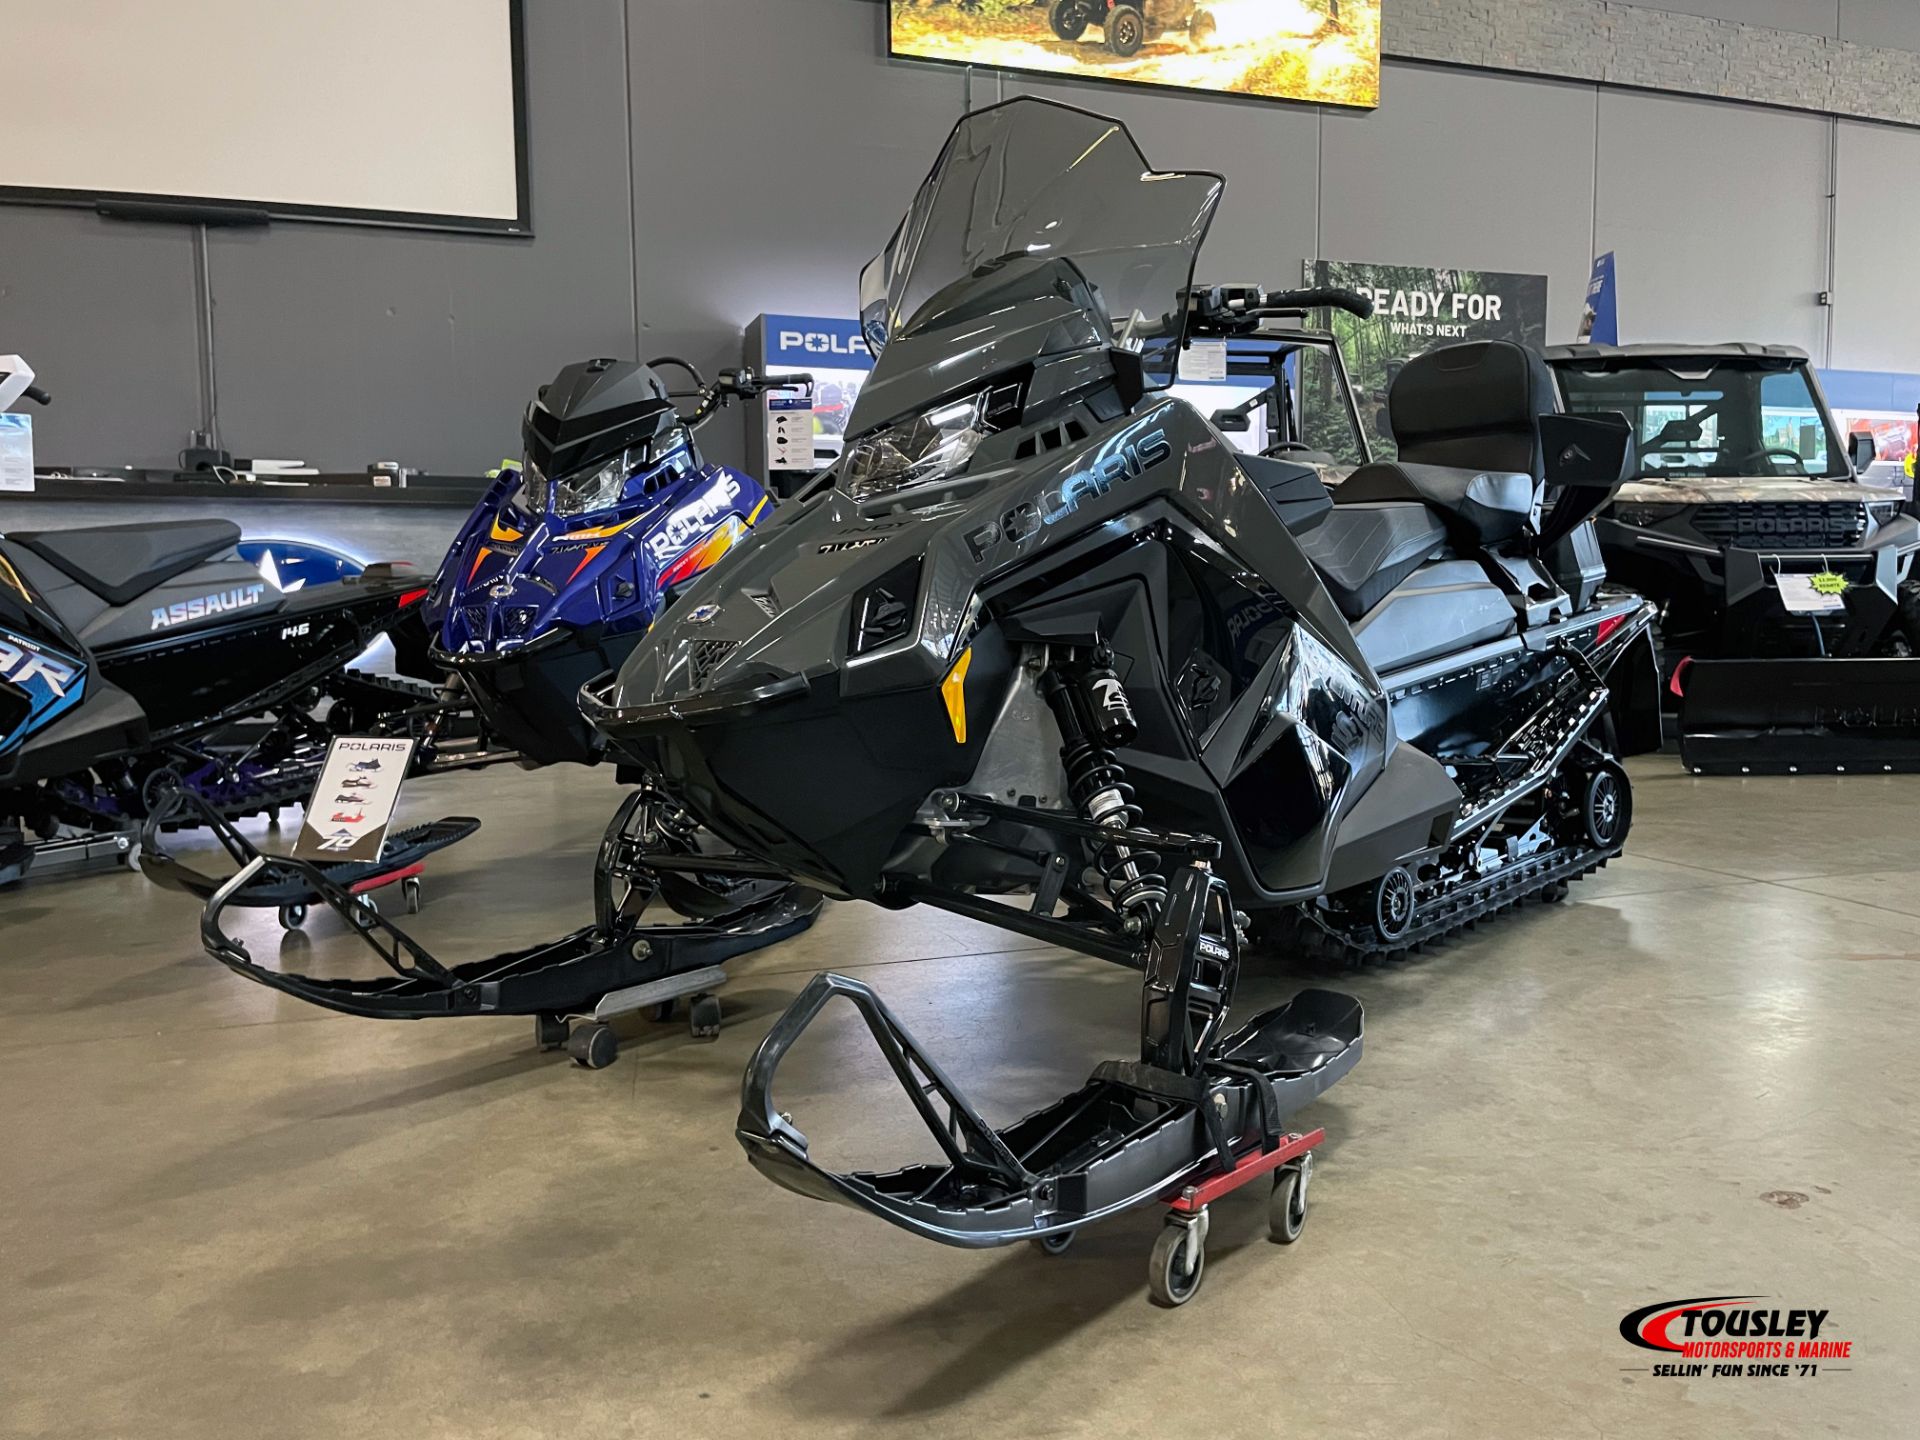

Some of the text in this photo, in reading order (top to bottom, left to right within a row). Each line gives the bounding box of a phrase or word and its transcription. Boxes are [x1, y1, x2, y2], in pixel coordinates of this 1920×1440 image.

[1452, 293, 1502, 321] FOR
[1390, 322, 1468, 338] WHAT'S NEXT
[780, 331, 871, 355] POLA
[962, 428, 1173, 564] POLARIS
[1738, 517, 1848, 533] POLARIS
[151, 584, 264, 630] ASSAULT
[281, 623, 310, 640] 146
[8, 635, 41, 652] PATRIOT
[338, 742, 407, 751] POLARIS
